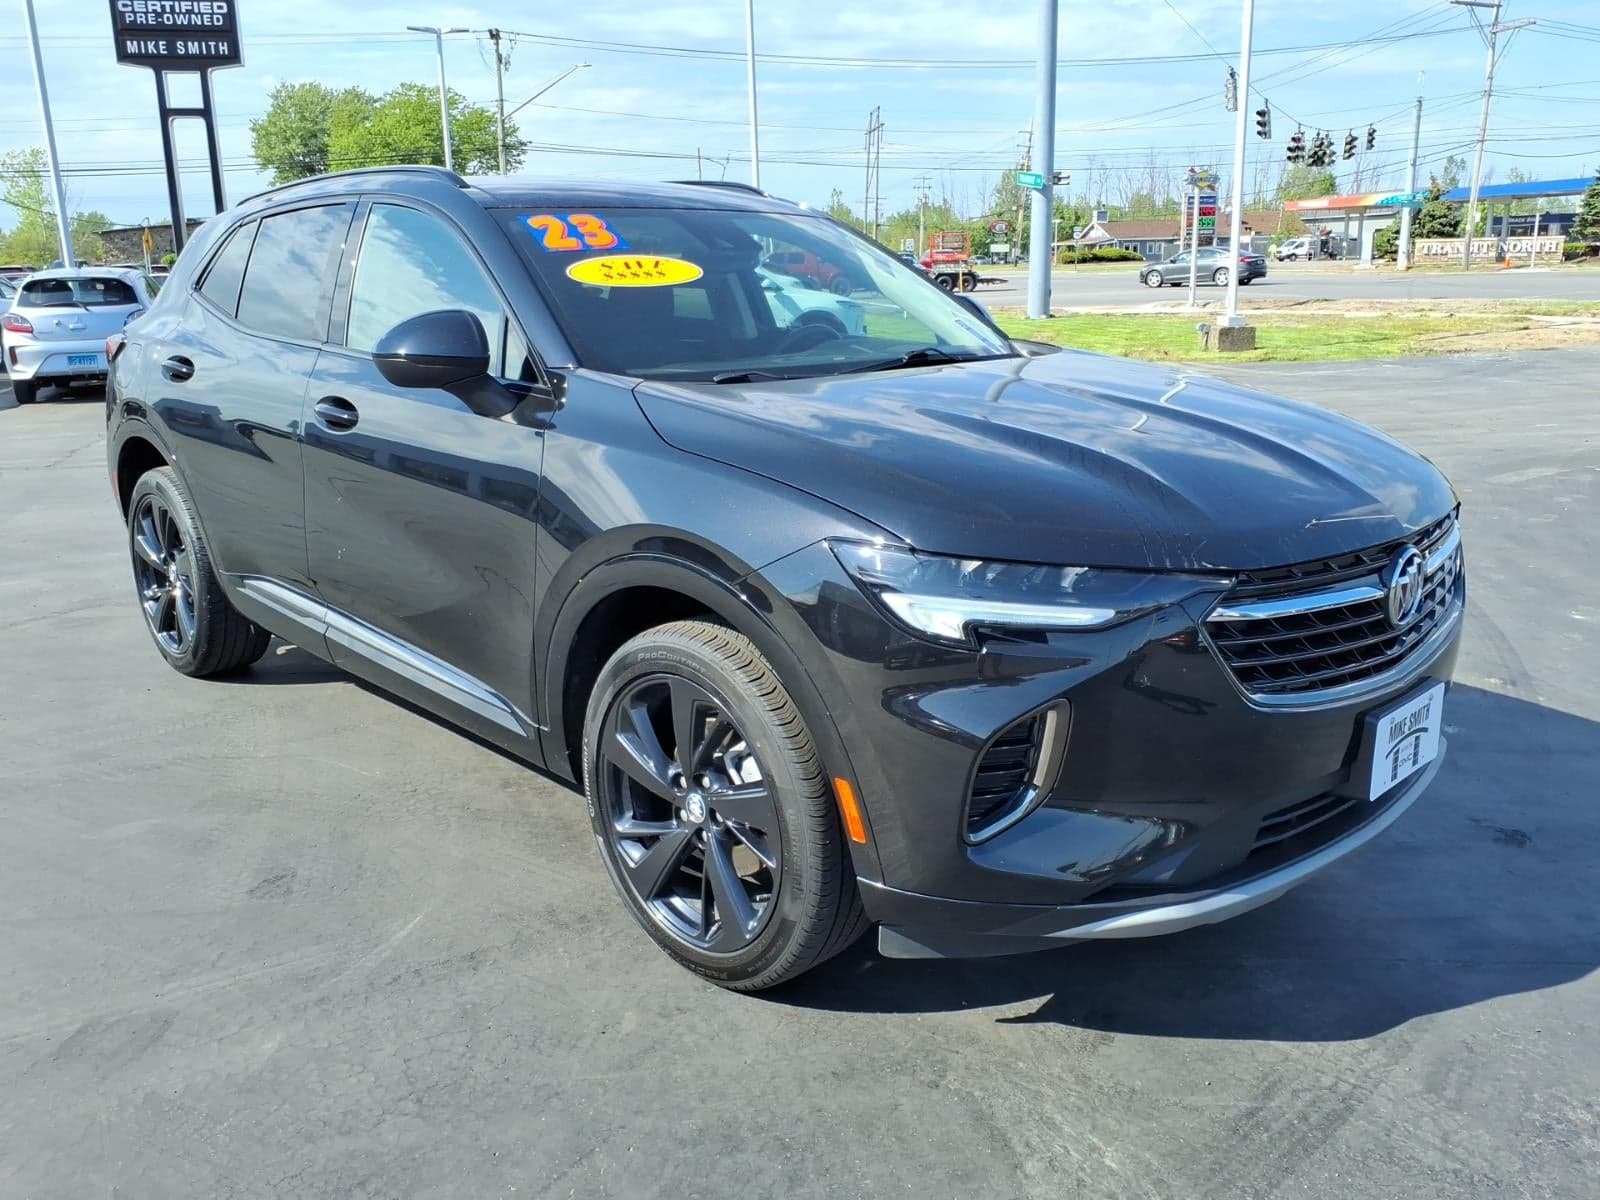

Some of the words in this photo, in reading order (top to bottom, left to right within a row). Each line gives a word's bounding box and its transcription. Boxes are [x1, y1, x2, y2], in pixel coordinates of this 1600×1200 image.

[118, 0, 228, 13] CERTIFIED
[125, 13, 223, 26] PRE-OWNED
[126, 40, 168, 54] MIKE
[176, 41, 229, 55] SMITH
[527, 213, 618, 251] 23
[1388, 716, 1408, 744] MIKE
[1408, 703, 1431, 732] SMITH
